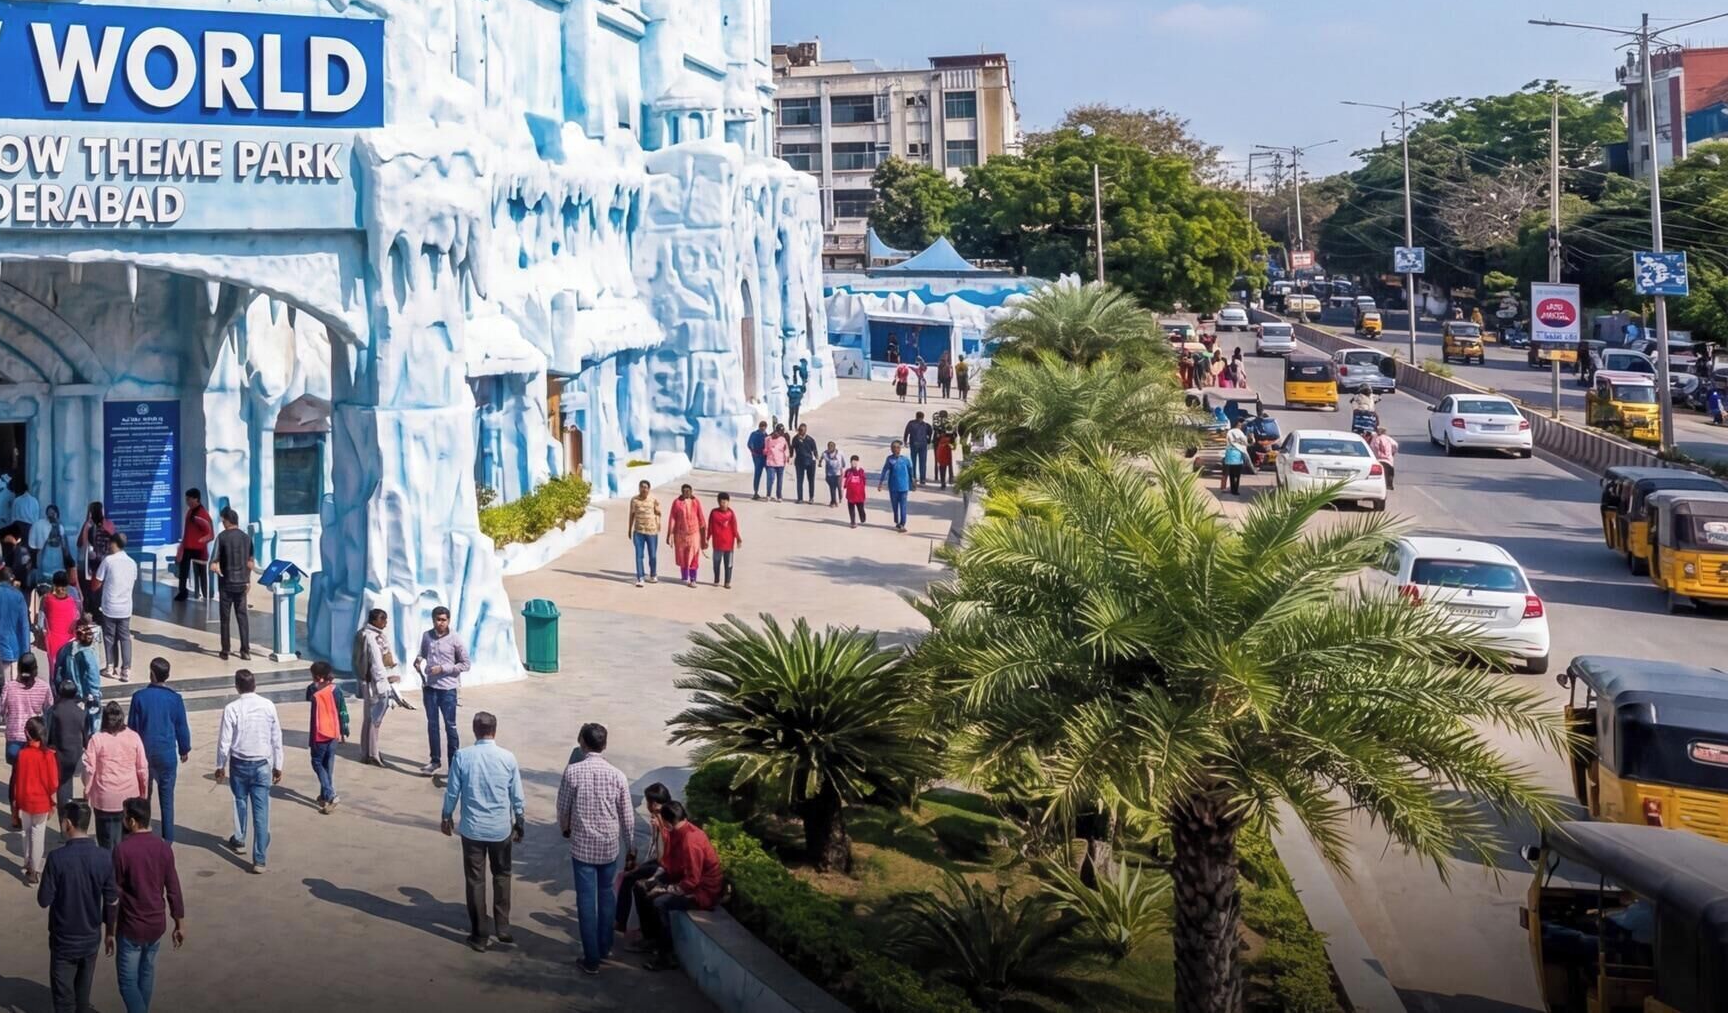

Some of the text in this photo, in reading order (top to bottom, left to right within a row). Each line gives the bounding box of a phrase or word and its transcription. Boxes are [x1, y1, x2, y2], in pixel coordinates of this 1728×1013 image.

[30, 23, 368, 114] WORLD
[81, 137, 223, 179] THEME
[237, 141, 344, 181] PARK
